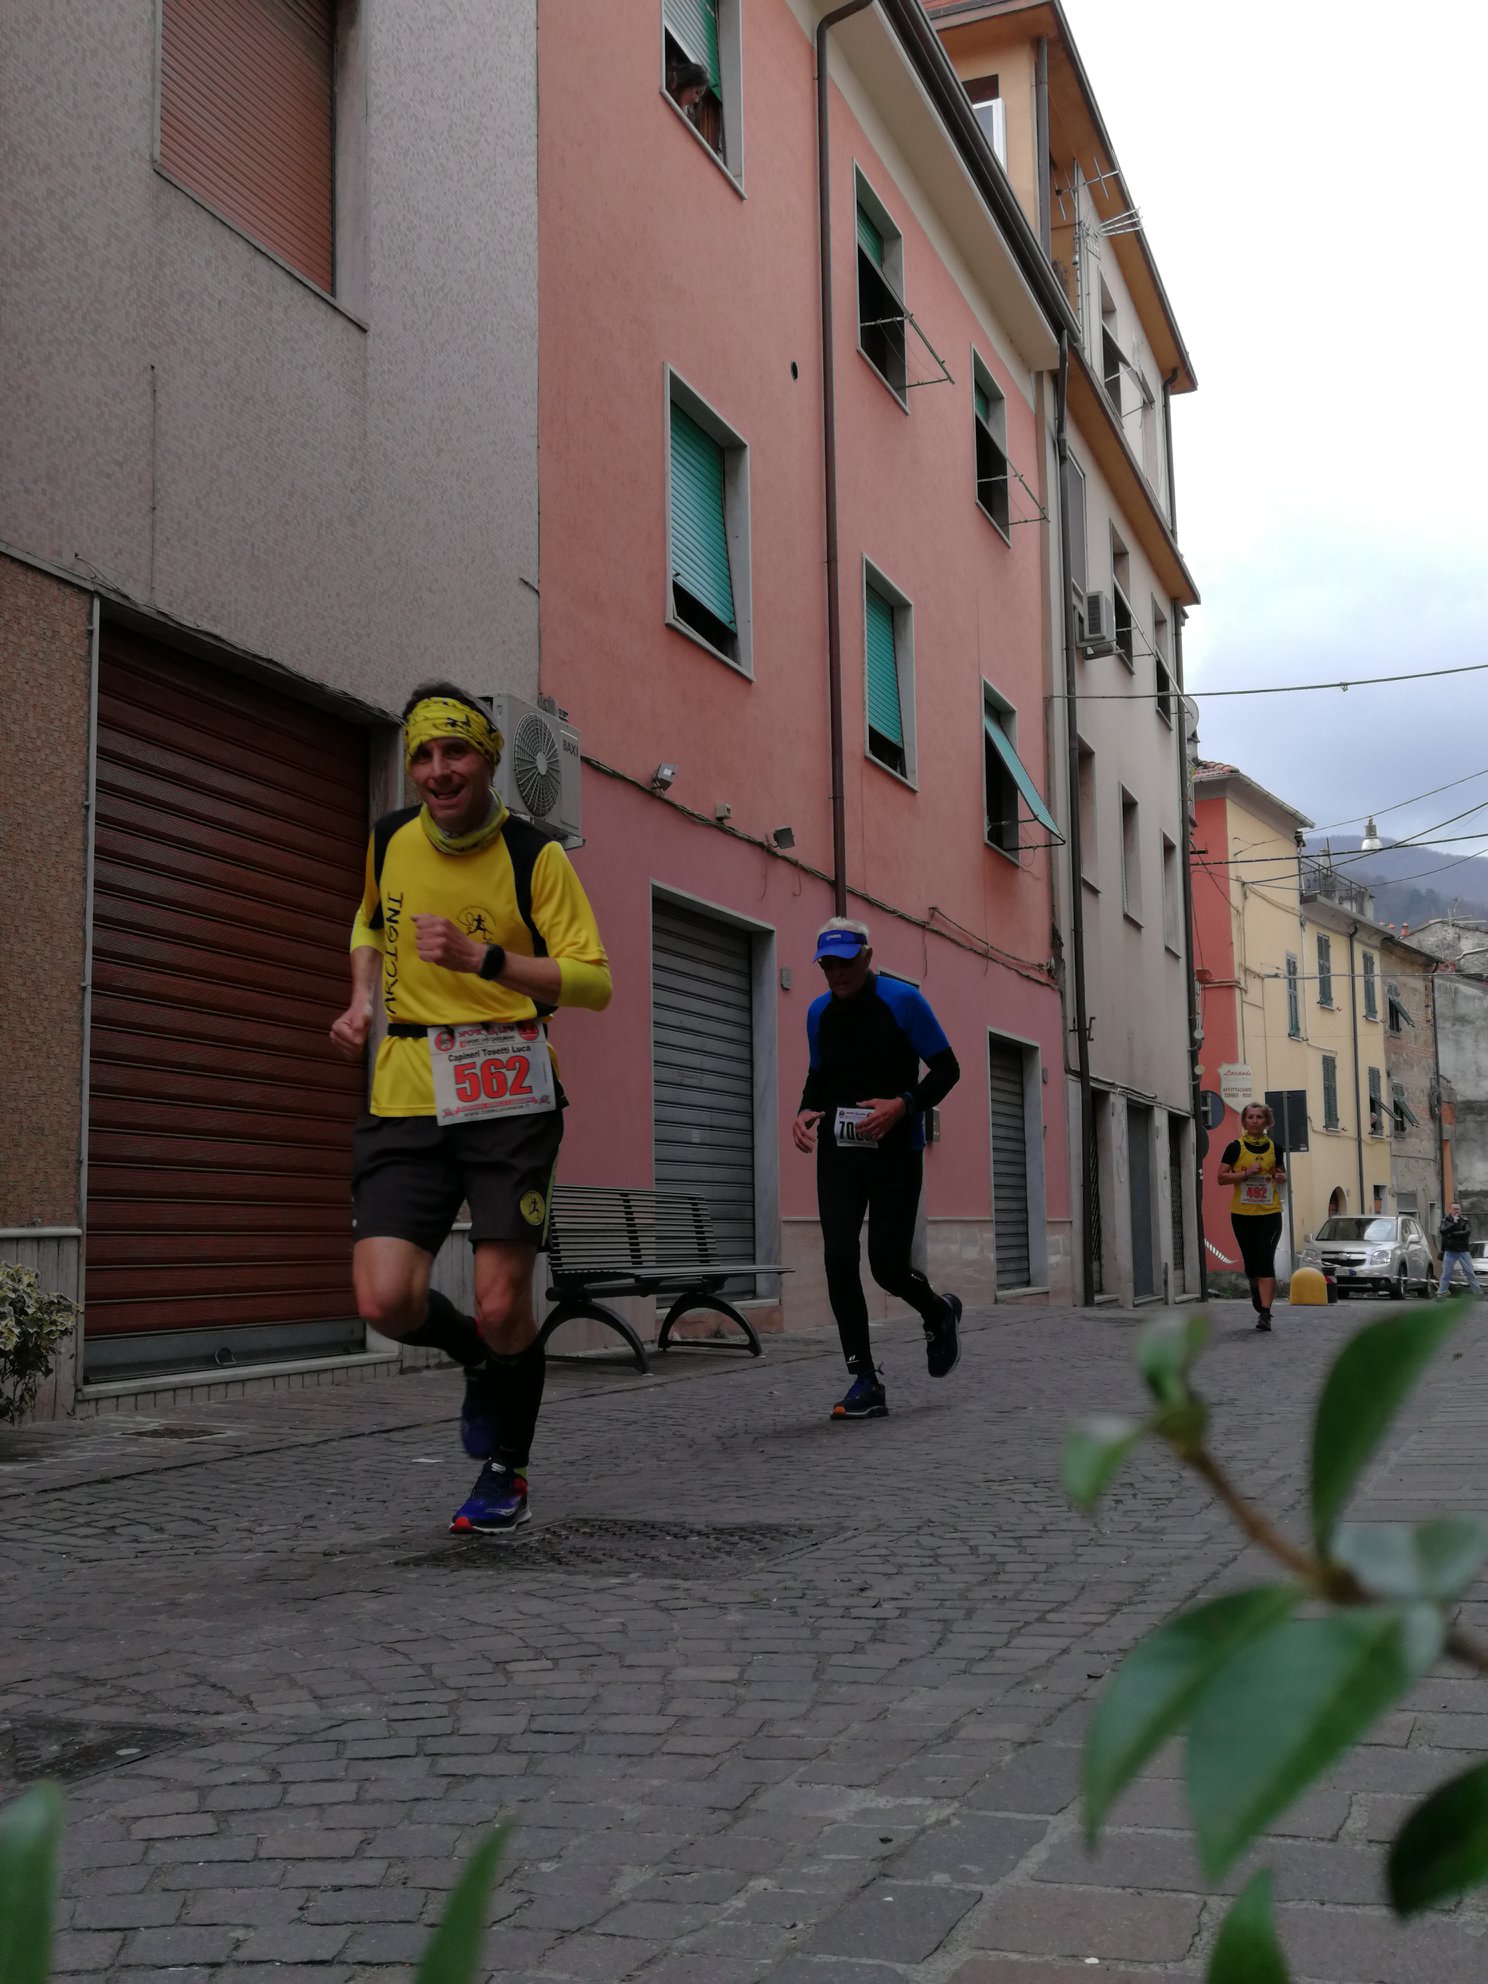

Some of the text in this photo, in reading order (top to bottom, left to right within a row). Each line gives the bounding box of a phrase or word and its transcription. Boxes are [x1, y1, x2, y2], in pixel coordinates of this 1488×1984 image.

[563, 740, 579, 758] BAXI
[483, 1047, 510, 1057] Tosetti
[512, 1044, 531, 1053] Luca
[454, 1055, 533, 1103] 562
